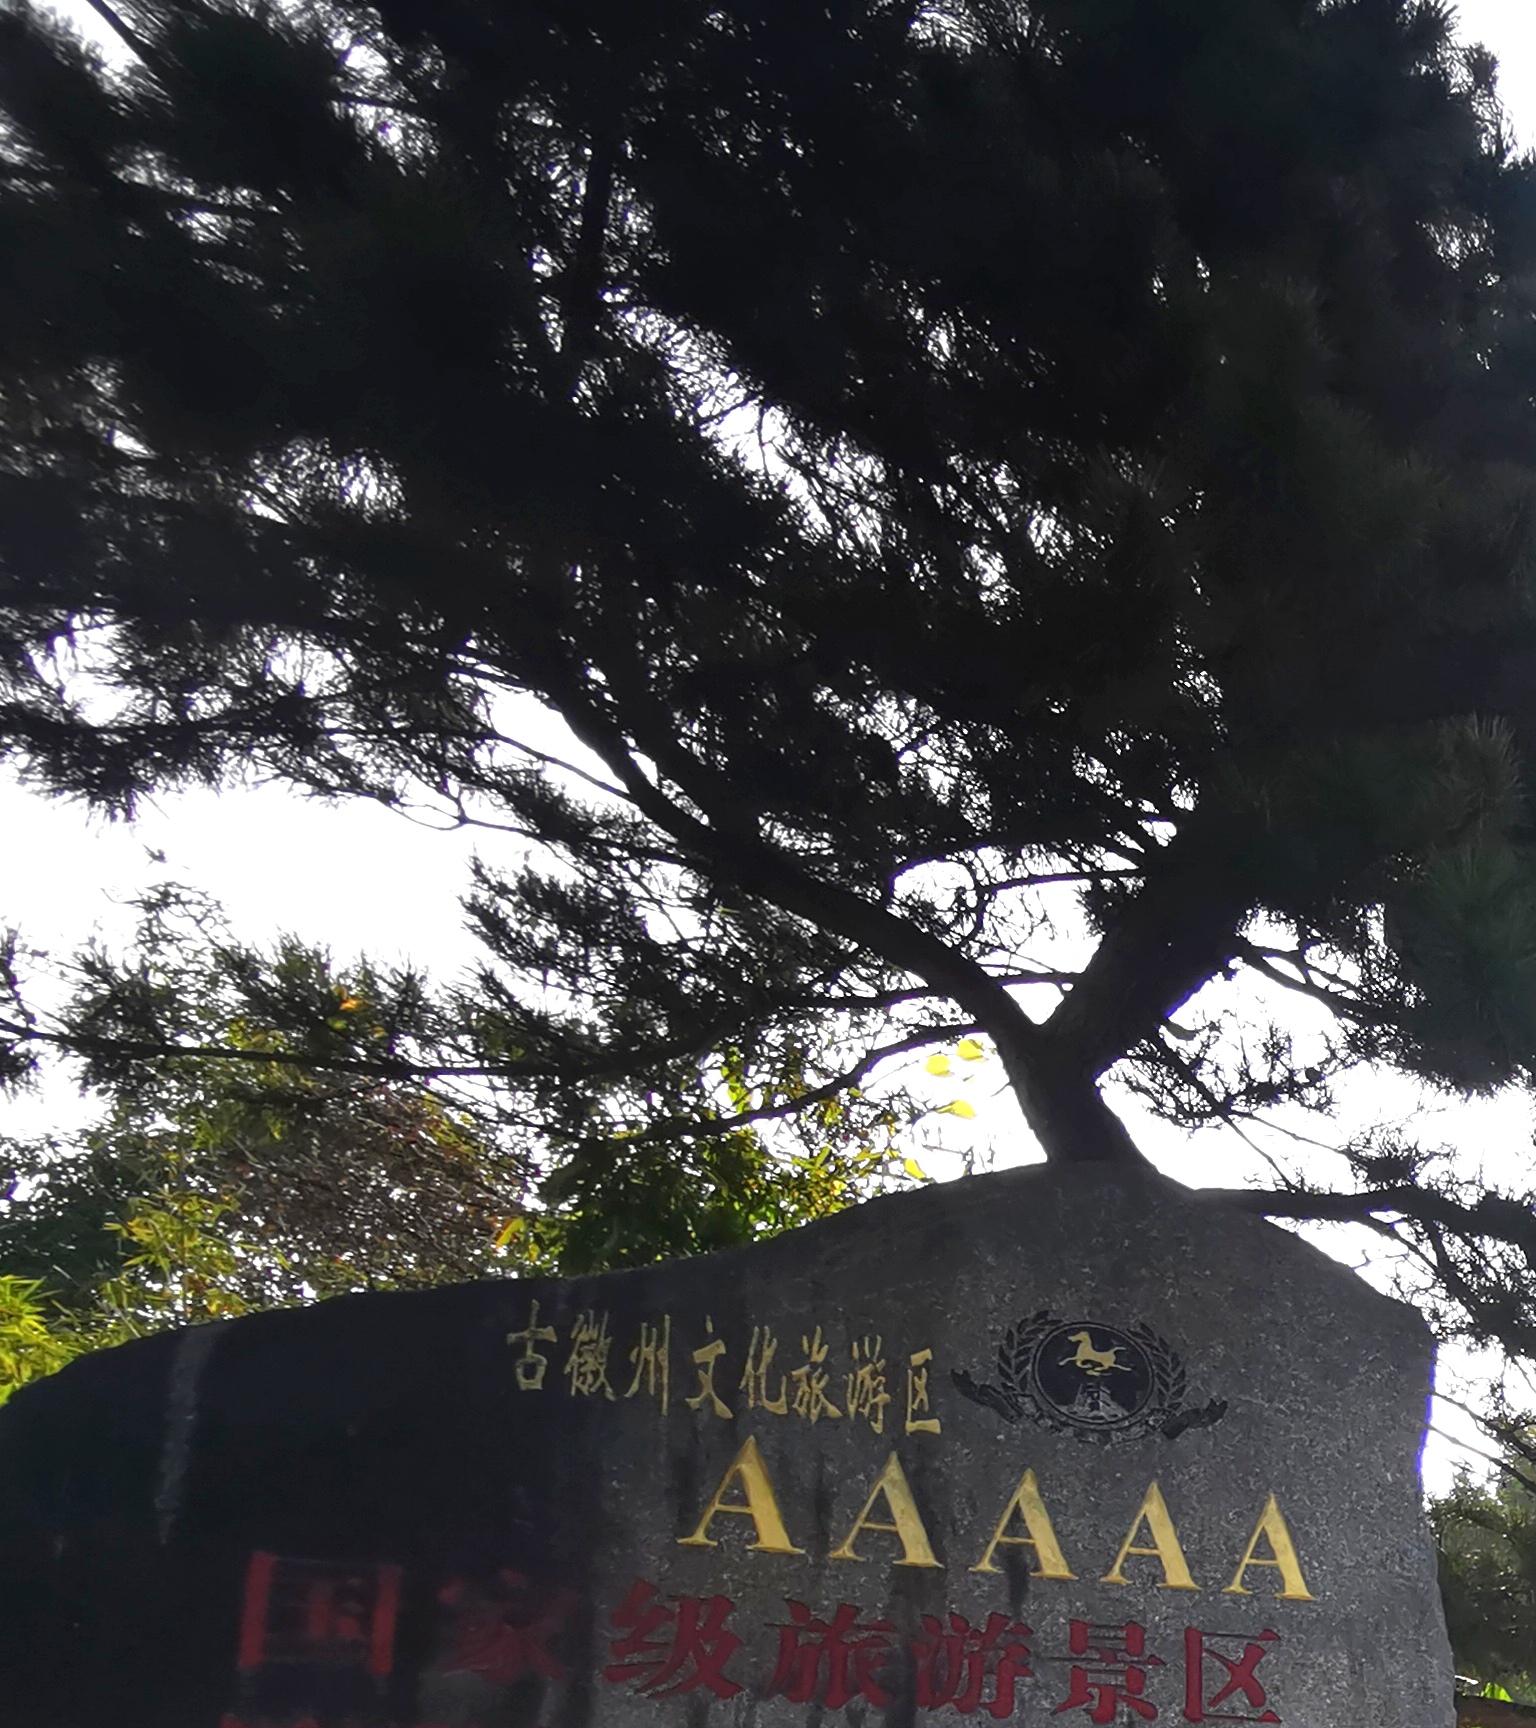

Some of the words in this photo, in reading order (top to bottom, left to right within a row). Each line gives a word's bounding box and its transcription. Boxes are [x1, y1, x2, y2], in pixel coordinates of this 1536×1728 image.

[506, 1299, 941, 1435] 古徽州文化旅游区
[676, 1435, 1314, 1599] AAAAA
[238, 1549, 1283, 1726] 国家级旅游景区
